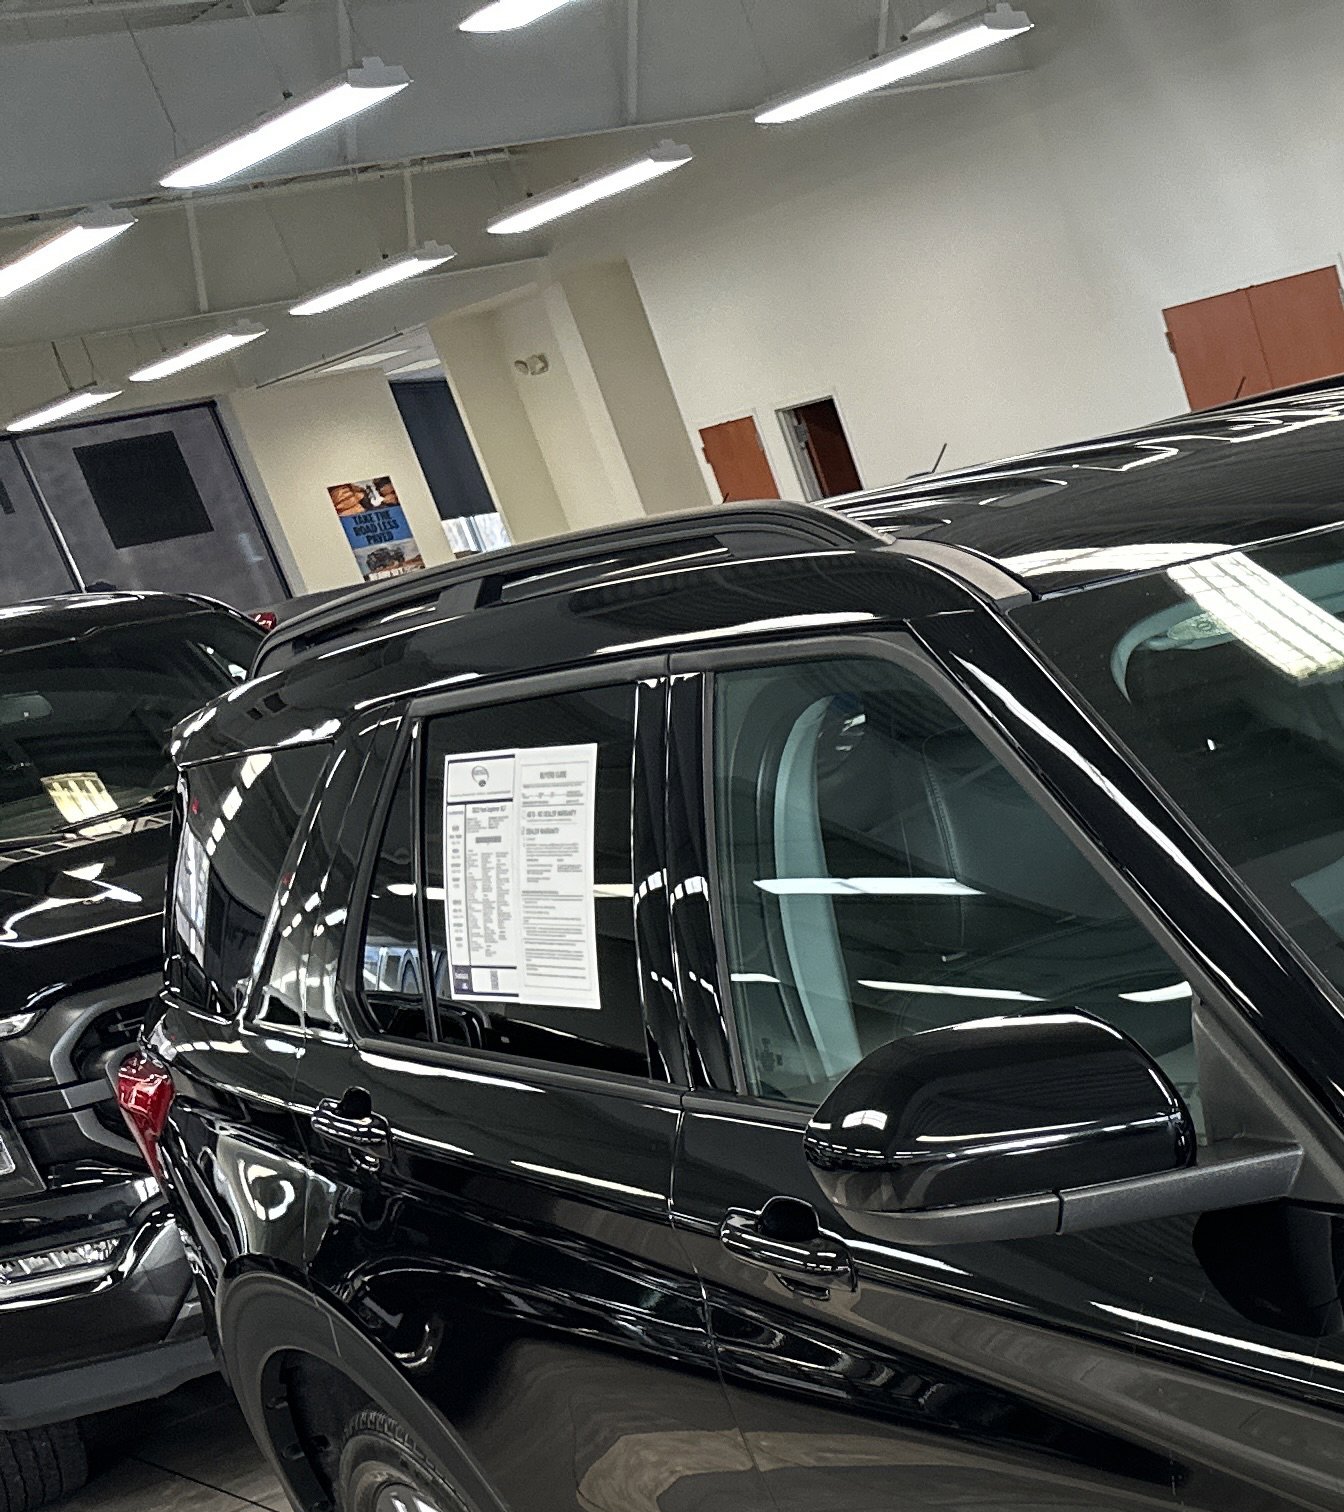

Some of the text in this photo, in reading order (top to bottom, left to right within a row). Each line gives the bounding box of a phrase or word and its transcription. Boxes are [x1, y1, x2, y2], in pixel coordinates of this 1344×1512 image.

[353, 510, 392, 525] TAKE THE
[353, 519, 400, 537] ROAD LESS
